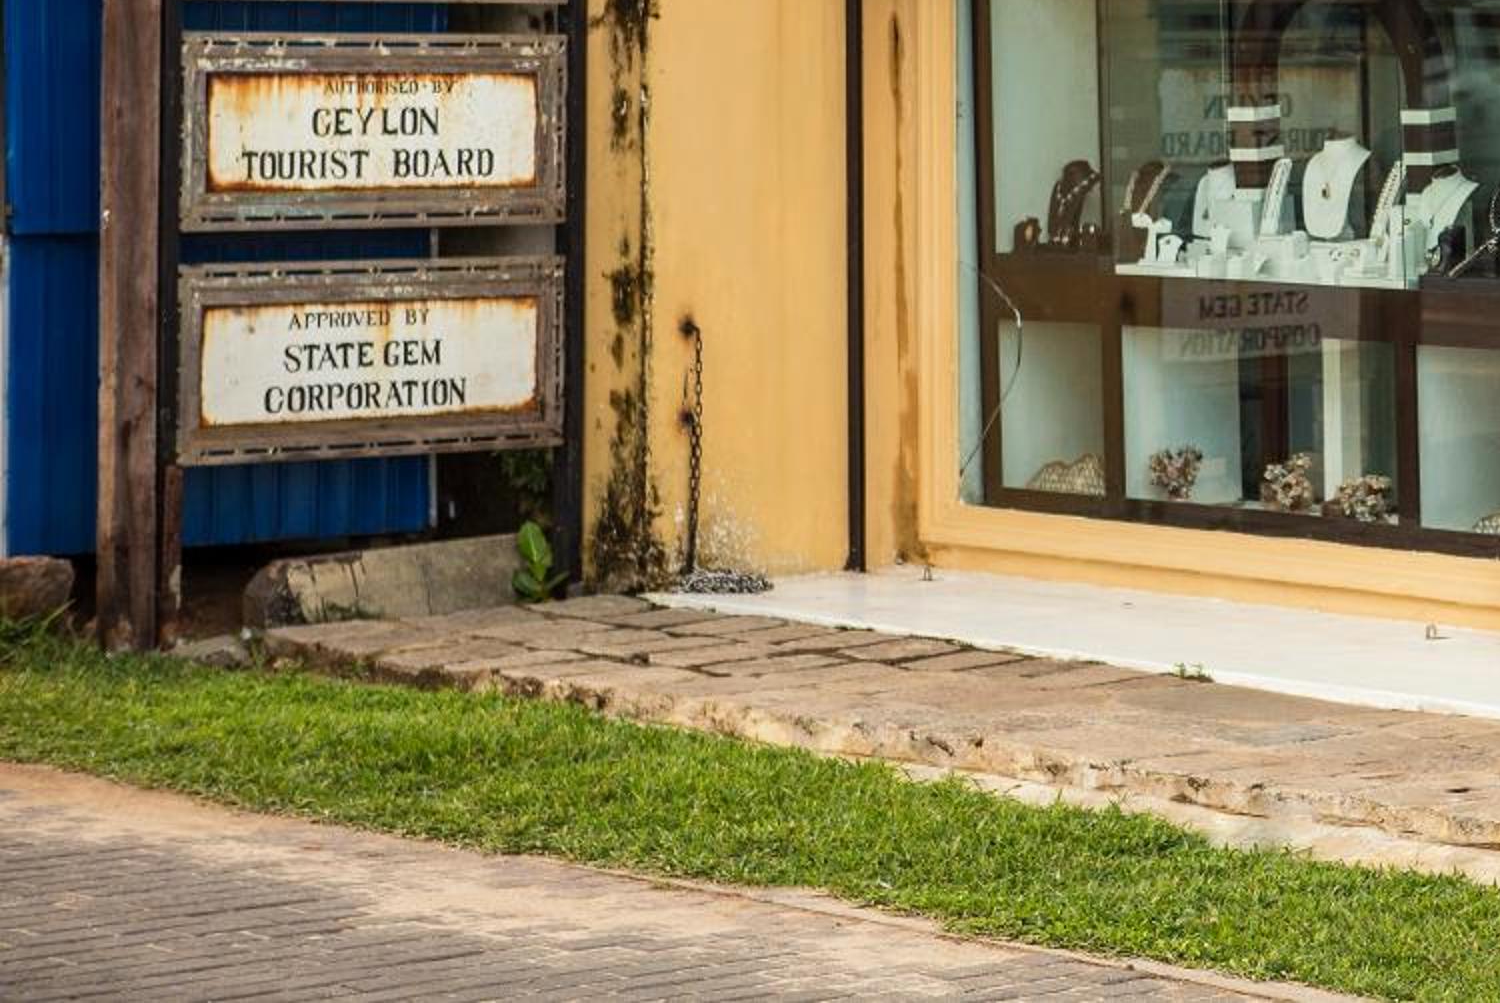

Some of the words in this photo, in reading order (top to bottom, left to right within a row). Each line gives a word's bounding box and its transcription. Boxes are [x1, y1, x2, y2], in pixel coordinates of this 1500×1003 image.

[312, 107, 440, 137] CEYLON
[242, 150, 369, 181] TOURIST
[393, 148, 494, 179] BOARD
[288, 310, 389, 330] APPROVED
[405, 308, 430, 326] BY
[284, 341, 374, 372] STATE
[384, 339, 442, 366] GEM
[264, 377, 467, 413] CORPORATION
